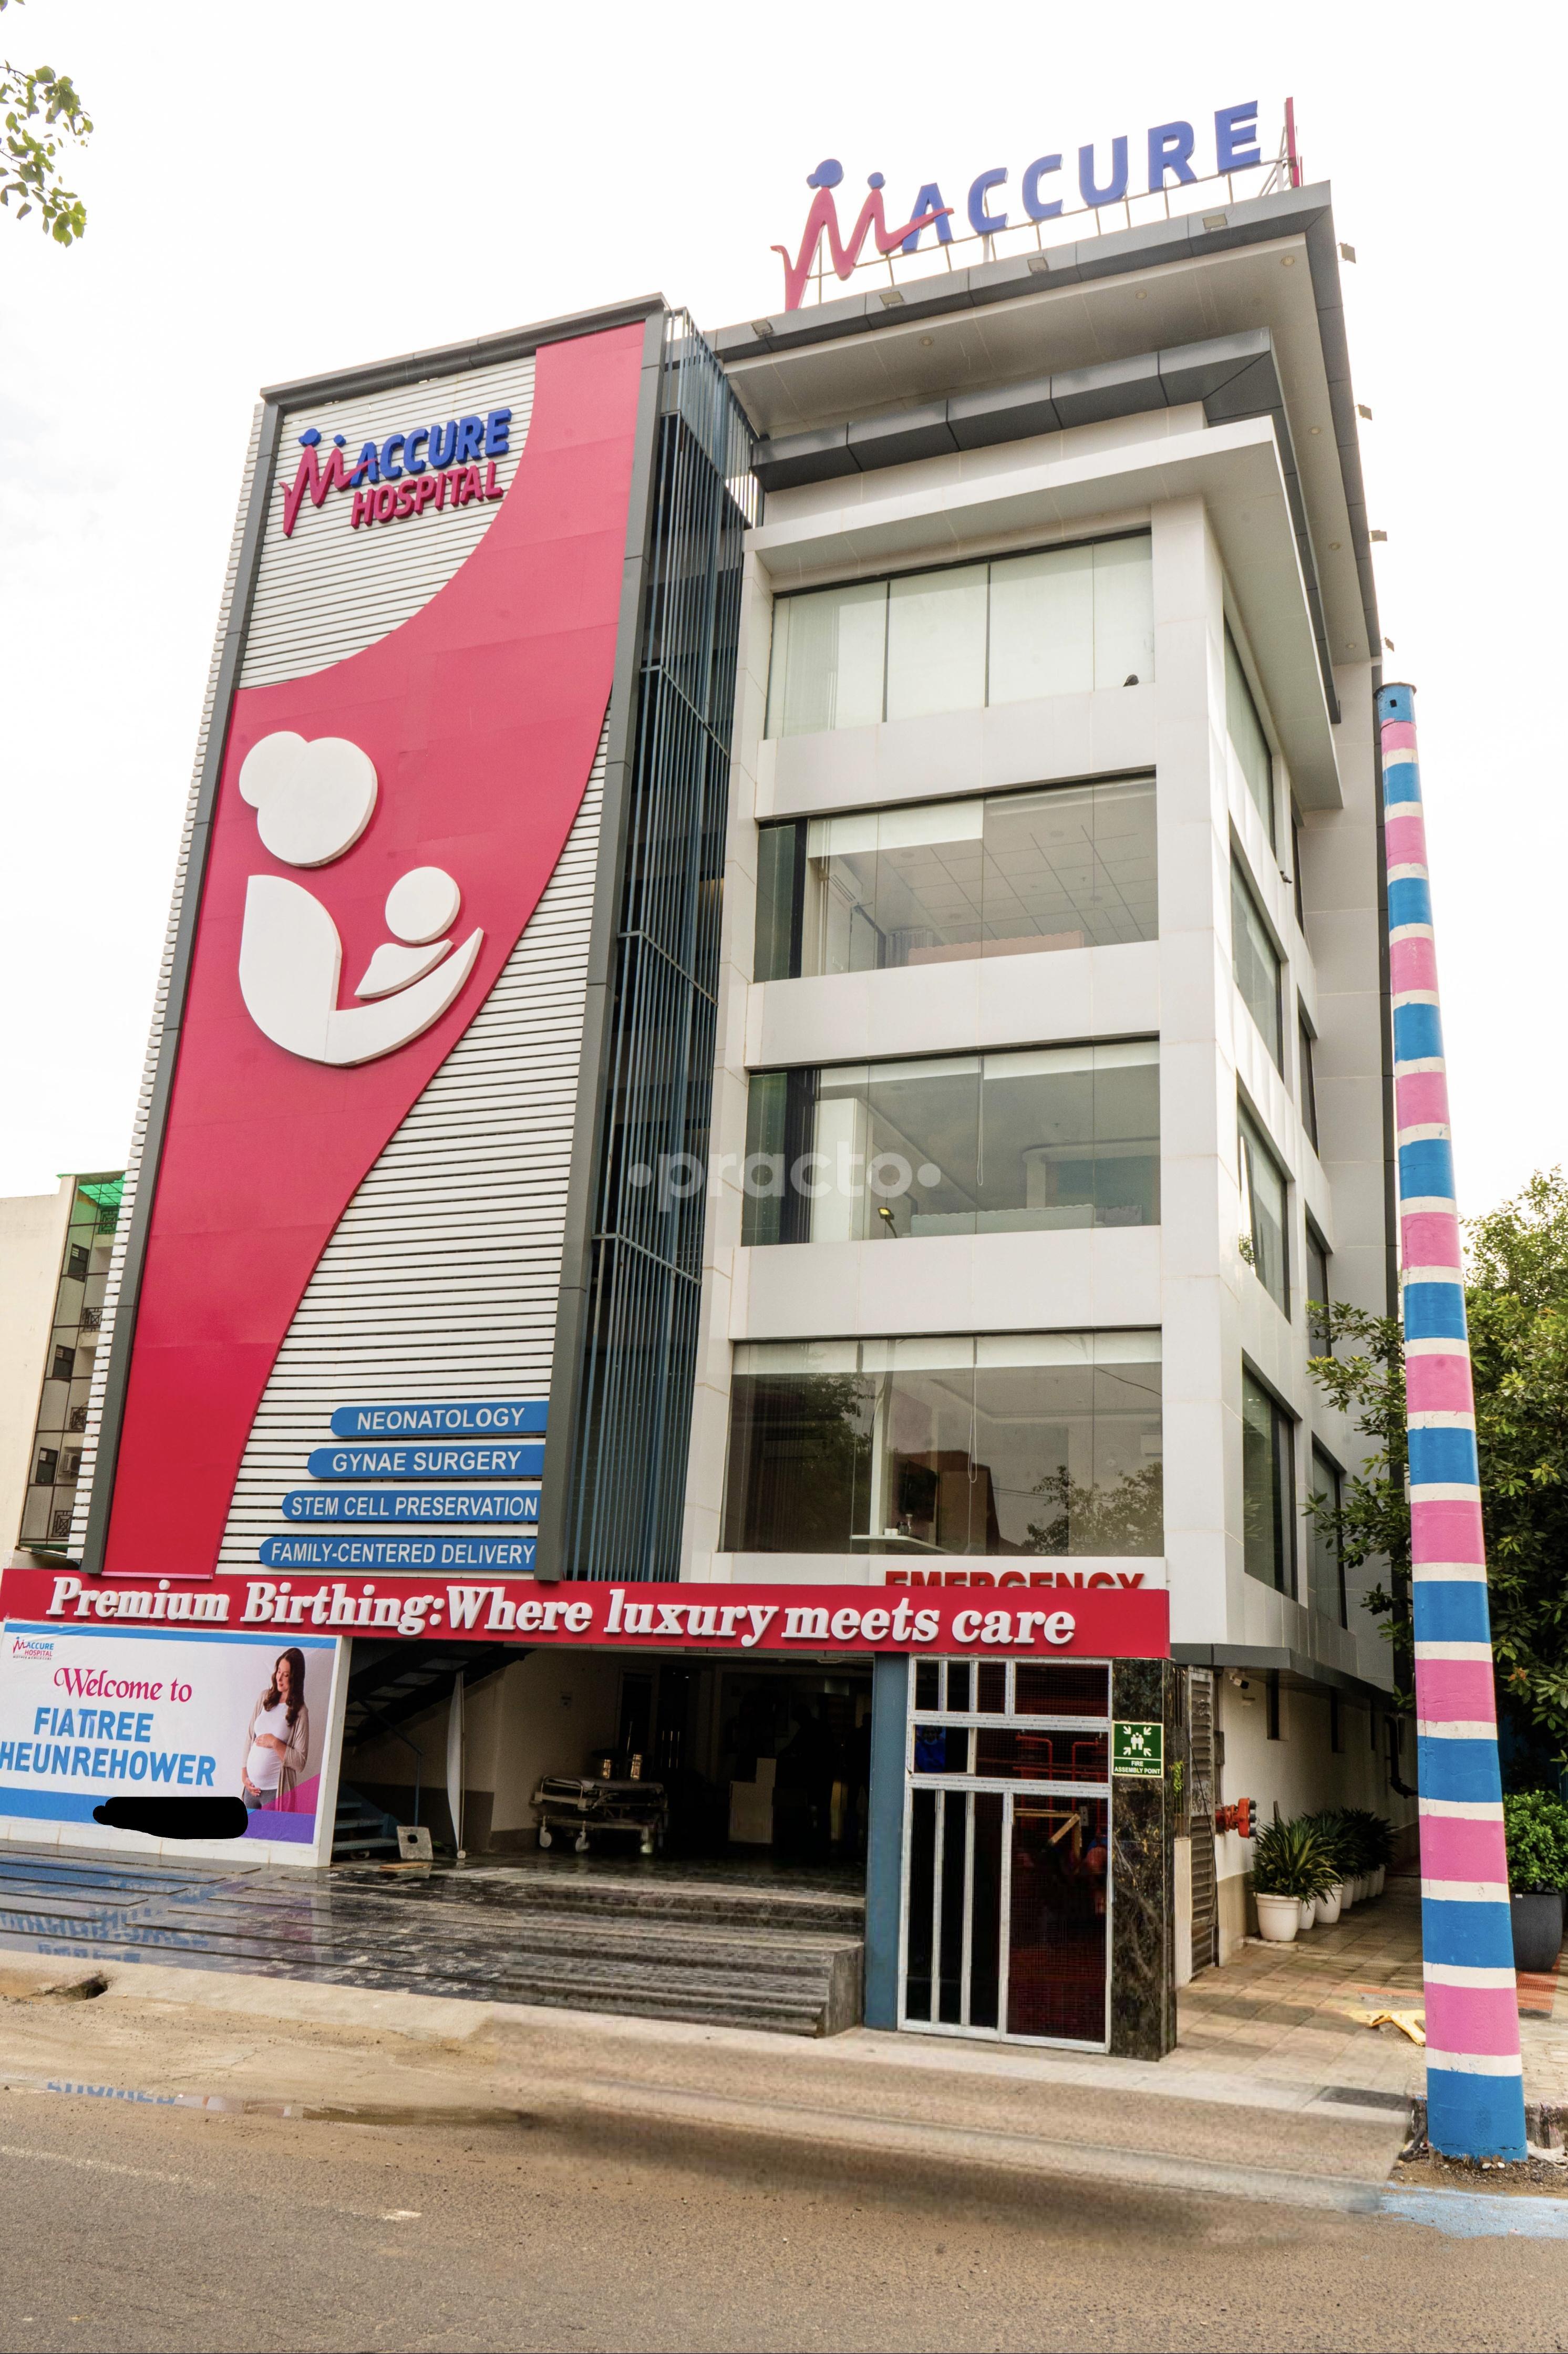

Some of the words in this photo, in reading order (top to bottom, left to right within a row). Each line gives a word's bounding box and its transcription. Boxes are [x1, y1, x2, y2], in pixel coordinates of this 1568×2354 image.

[350, 460, 504, 530] HOSPITAL
[357, 1407, 525, 1430] NEONATOLOGY
[332, 1452, 407, 1472] GYNAE
[413, 1451, 522, 1471] SURGERY
[292, 1496, 339, 1516] STEM
[344, 1496, 389, 1516] CELL
[395, 1496, 538, 1516] PRESERVATION
[271, 1542, 436, 1563] FAMILY-CENTERED
[441, 1544, 535, 1564] DELIVERY
[46, 1577, 230, 1622] Premium
[603, 1588, 778, 1647] luxury
[781, 1598, 941, 1643] meets
[952, 1610, 1076, 1645] care
[54, 1667, 163, 1701] Welcome
[170, 1678, 192, 1702] to
